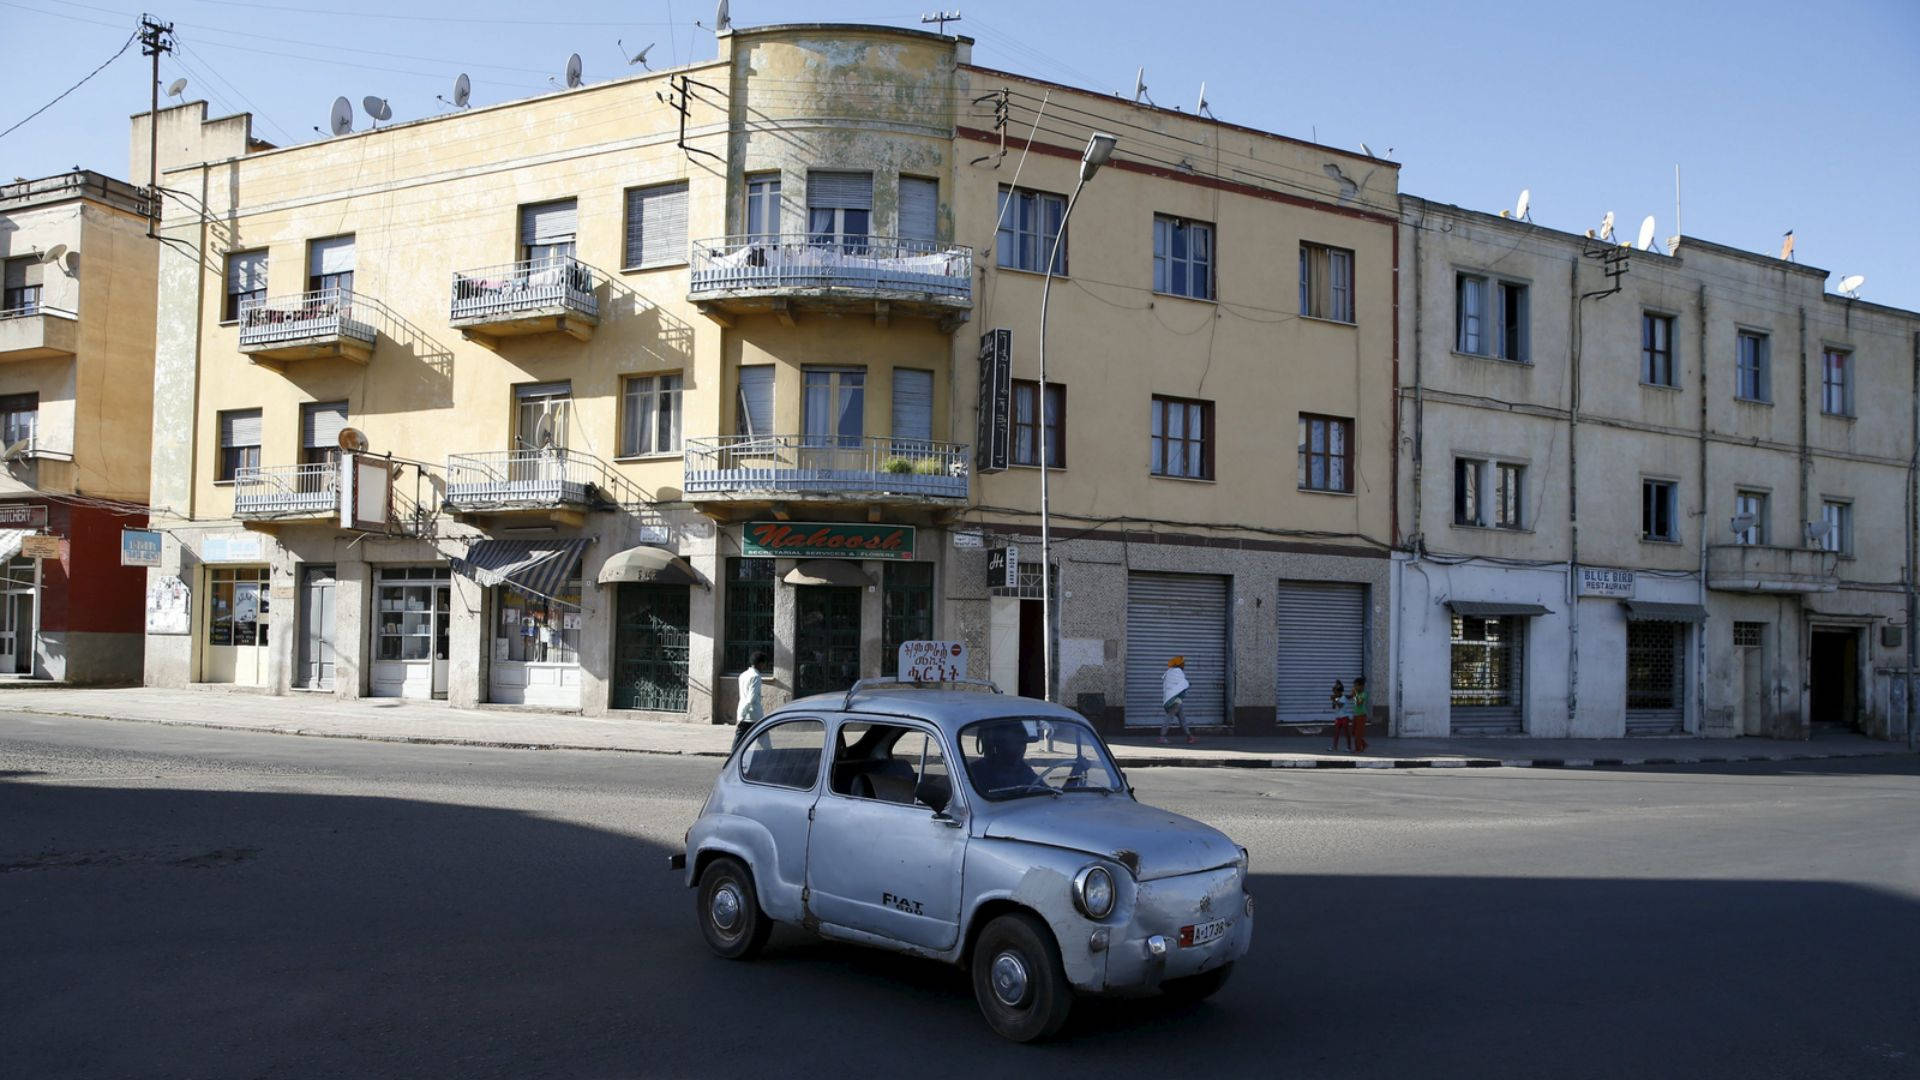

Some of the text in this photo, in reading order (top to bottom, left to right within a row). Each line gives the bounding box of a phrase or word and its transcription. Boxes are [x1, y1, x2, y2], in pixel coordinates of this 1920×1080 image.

[754, 524, 904, 549] Nahoosh
[1585, 570, 1633, 582] BLUE BIRD
[1586, 581, 1631, 590] RESTAURANT
[883, 892, 924, 908] FIAT
